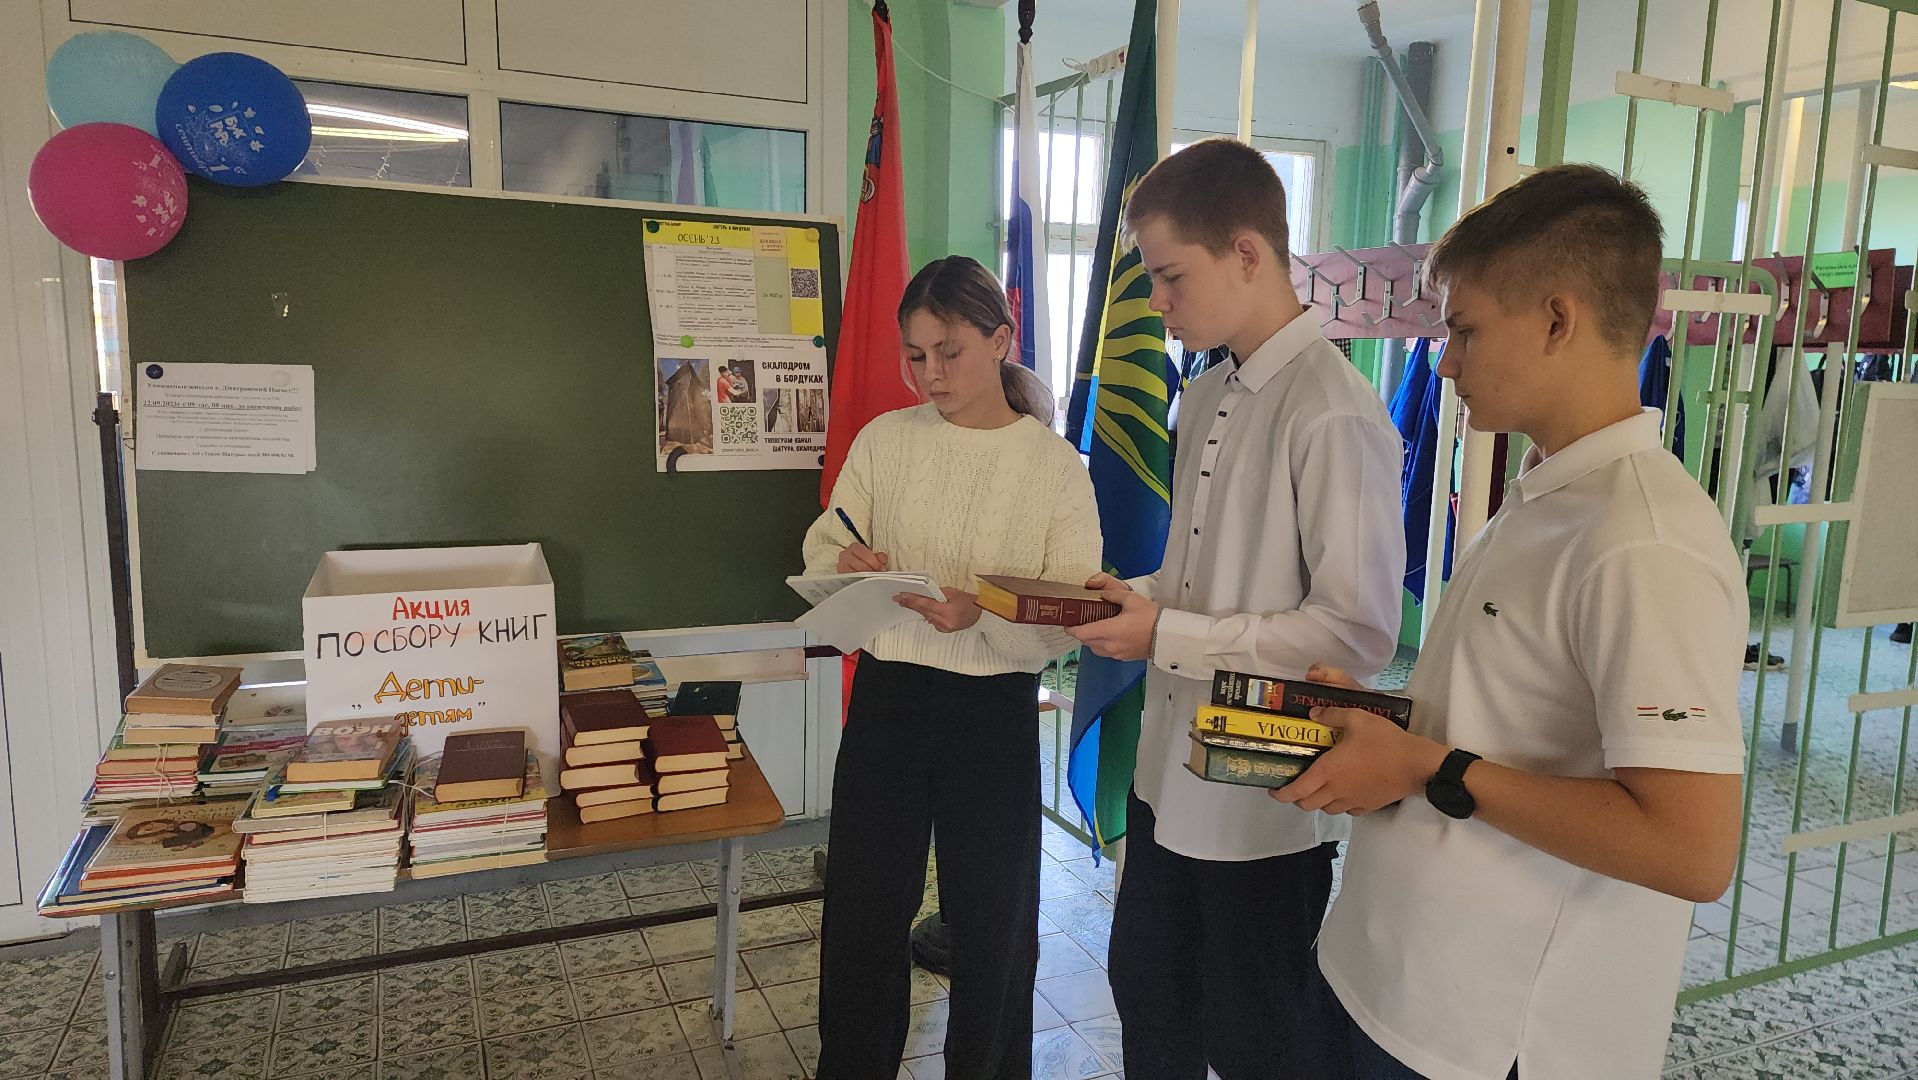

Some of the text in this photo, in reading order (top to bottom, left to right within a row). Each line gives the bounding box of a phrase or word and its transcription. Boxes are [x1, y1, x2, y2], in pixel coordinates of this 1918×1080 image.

[762, 361, 811, 371] СКАЛОДРОМ
[775, 374, 824, 384] В БОРДУКАХ
[392, 596, 471, 620] Акция
[315, 613, 548, 660] ПО СБОРУ КНИГ
